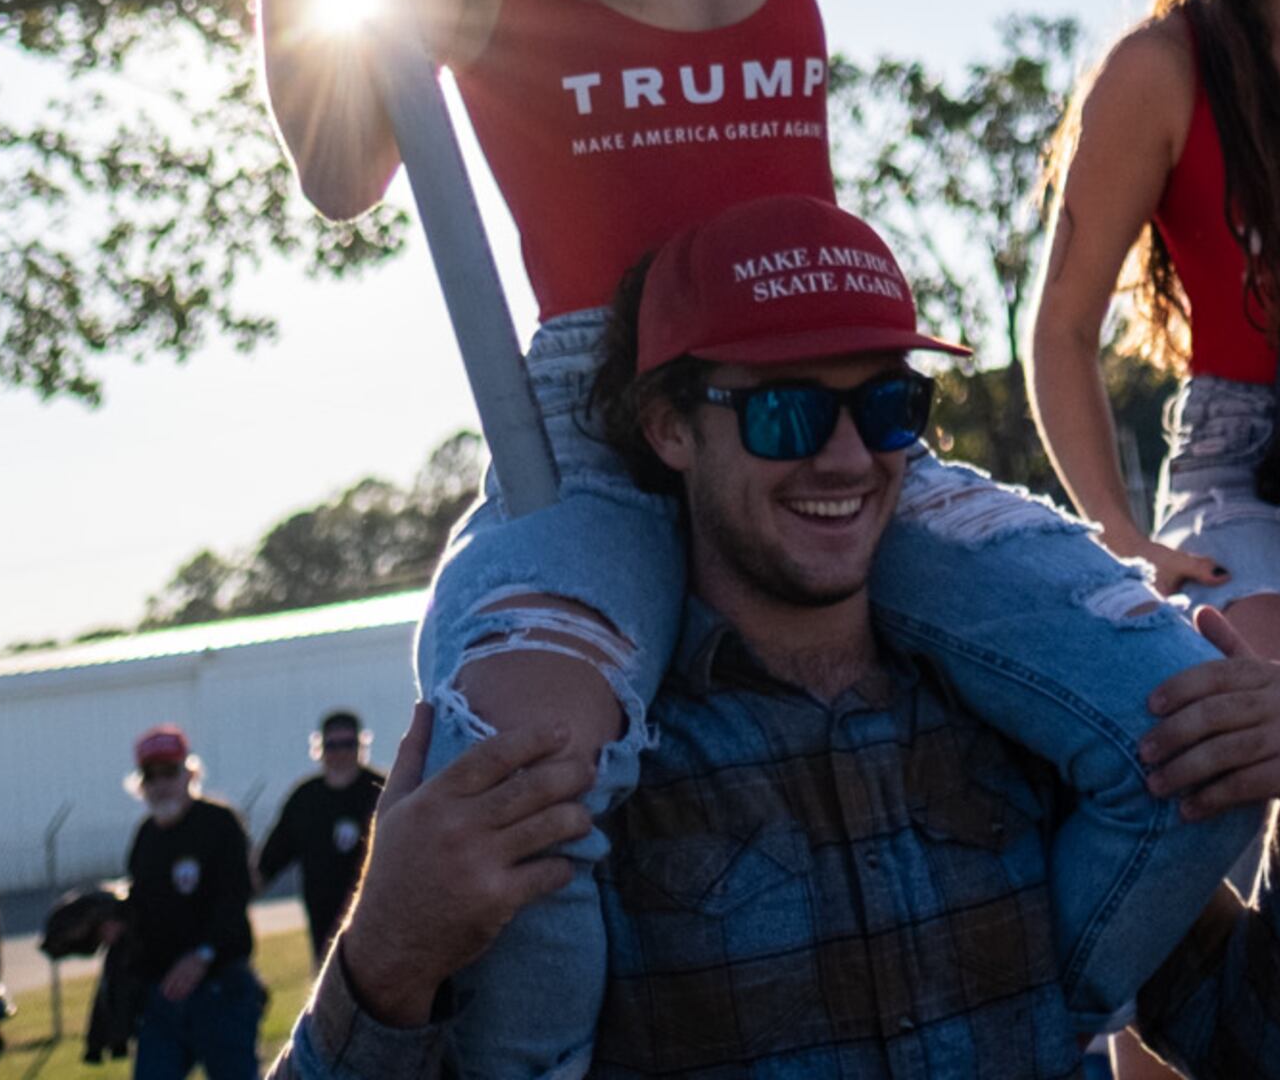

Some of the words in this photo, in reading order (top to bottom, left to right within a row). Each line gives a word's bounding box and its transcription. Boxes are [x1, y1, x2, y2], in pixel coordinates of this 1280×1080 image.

[562, 57, 825, 115] TRUMP
[572, 134, 625, 156] MAKE
[632, 125, 719, 149] AMERICA
[725, 121, 779, 141] GREAT
[733, 247, 811, 282] MAKE
[753, 271, 838, 303] SKATE
[843, 272, 903, 301] AGAIN
